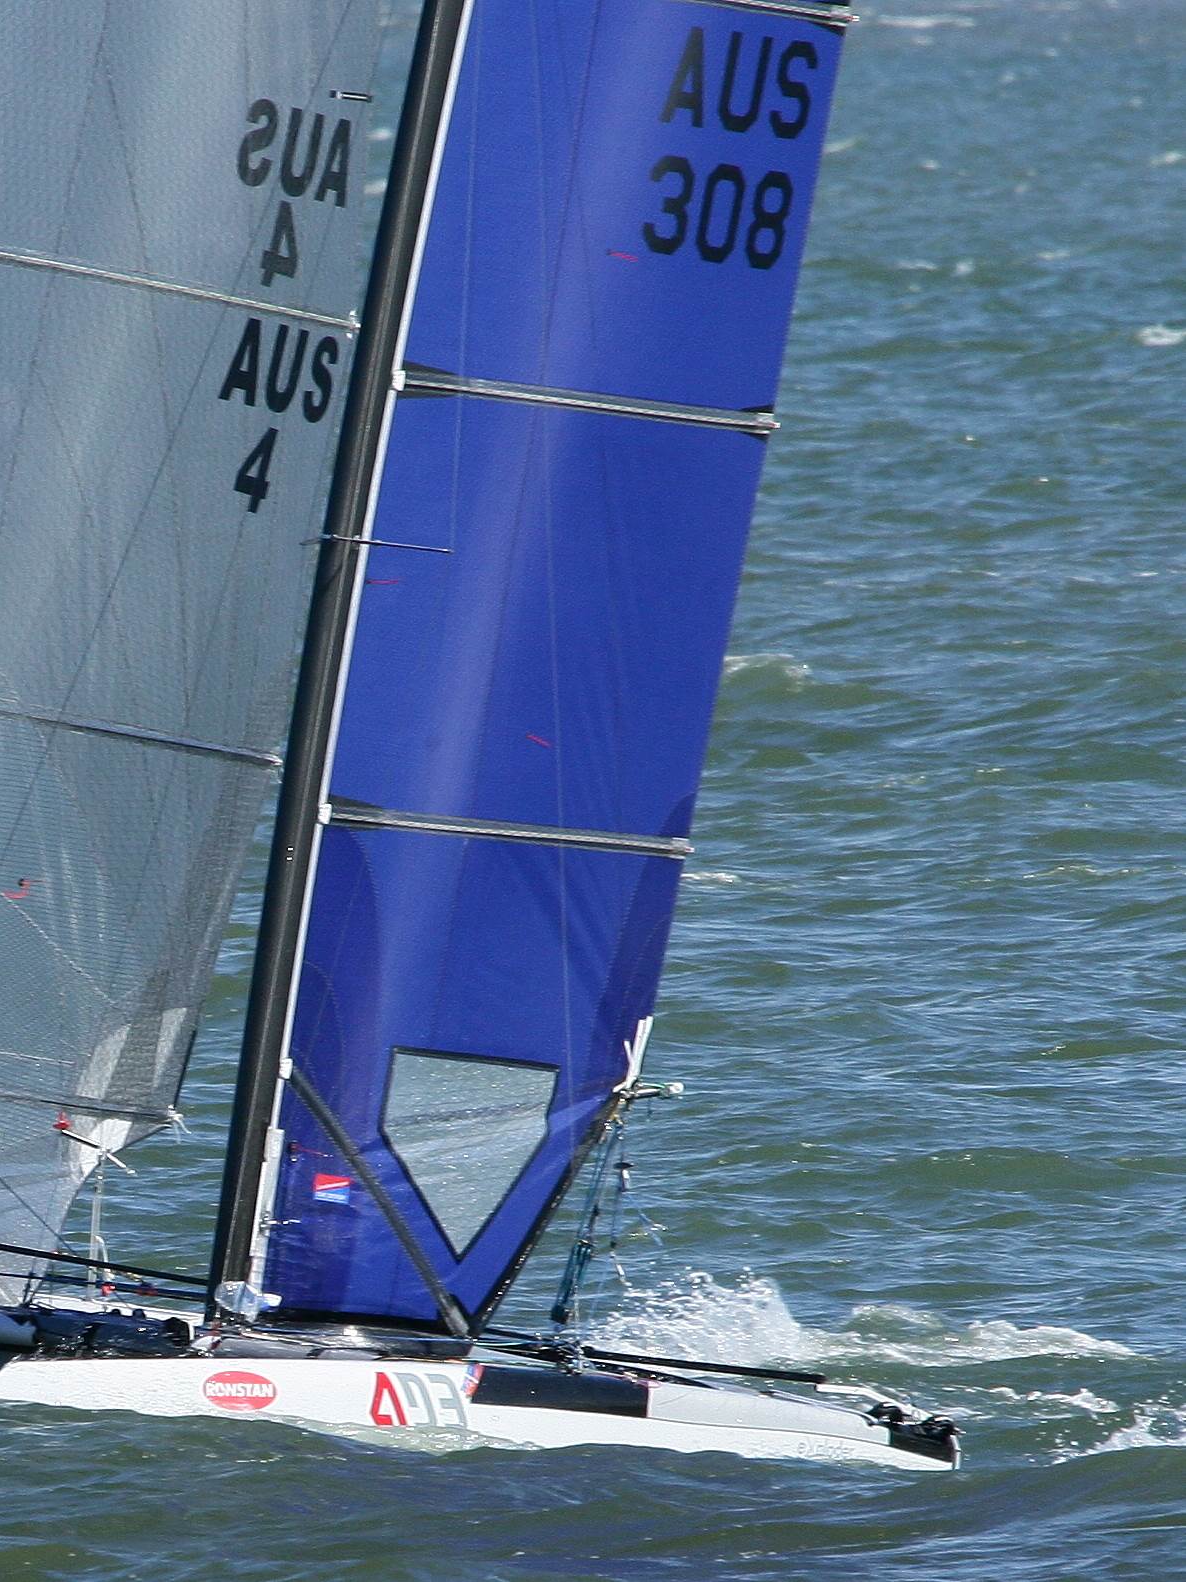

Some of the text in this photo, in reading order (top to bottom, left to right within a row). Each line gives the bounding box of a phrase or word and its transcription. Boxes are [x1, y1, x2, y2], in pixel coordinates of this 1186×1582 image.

[661, 26, 818, 138] AUS
[643, 155, 793, 270] 308
[218, 317, 338, 423] AUS
[234, 426, 278, 513] 4
[206, 1382, 273, 1398] RONSTAN
